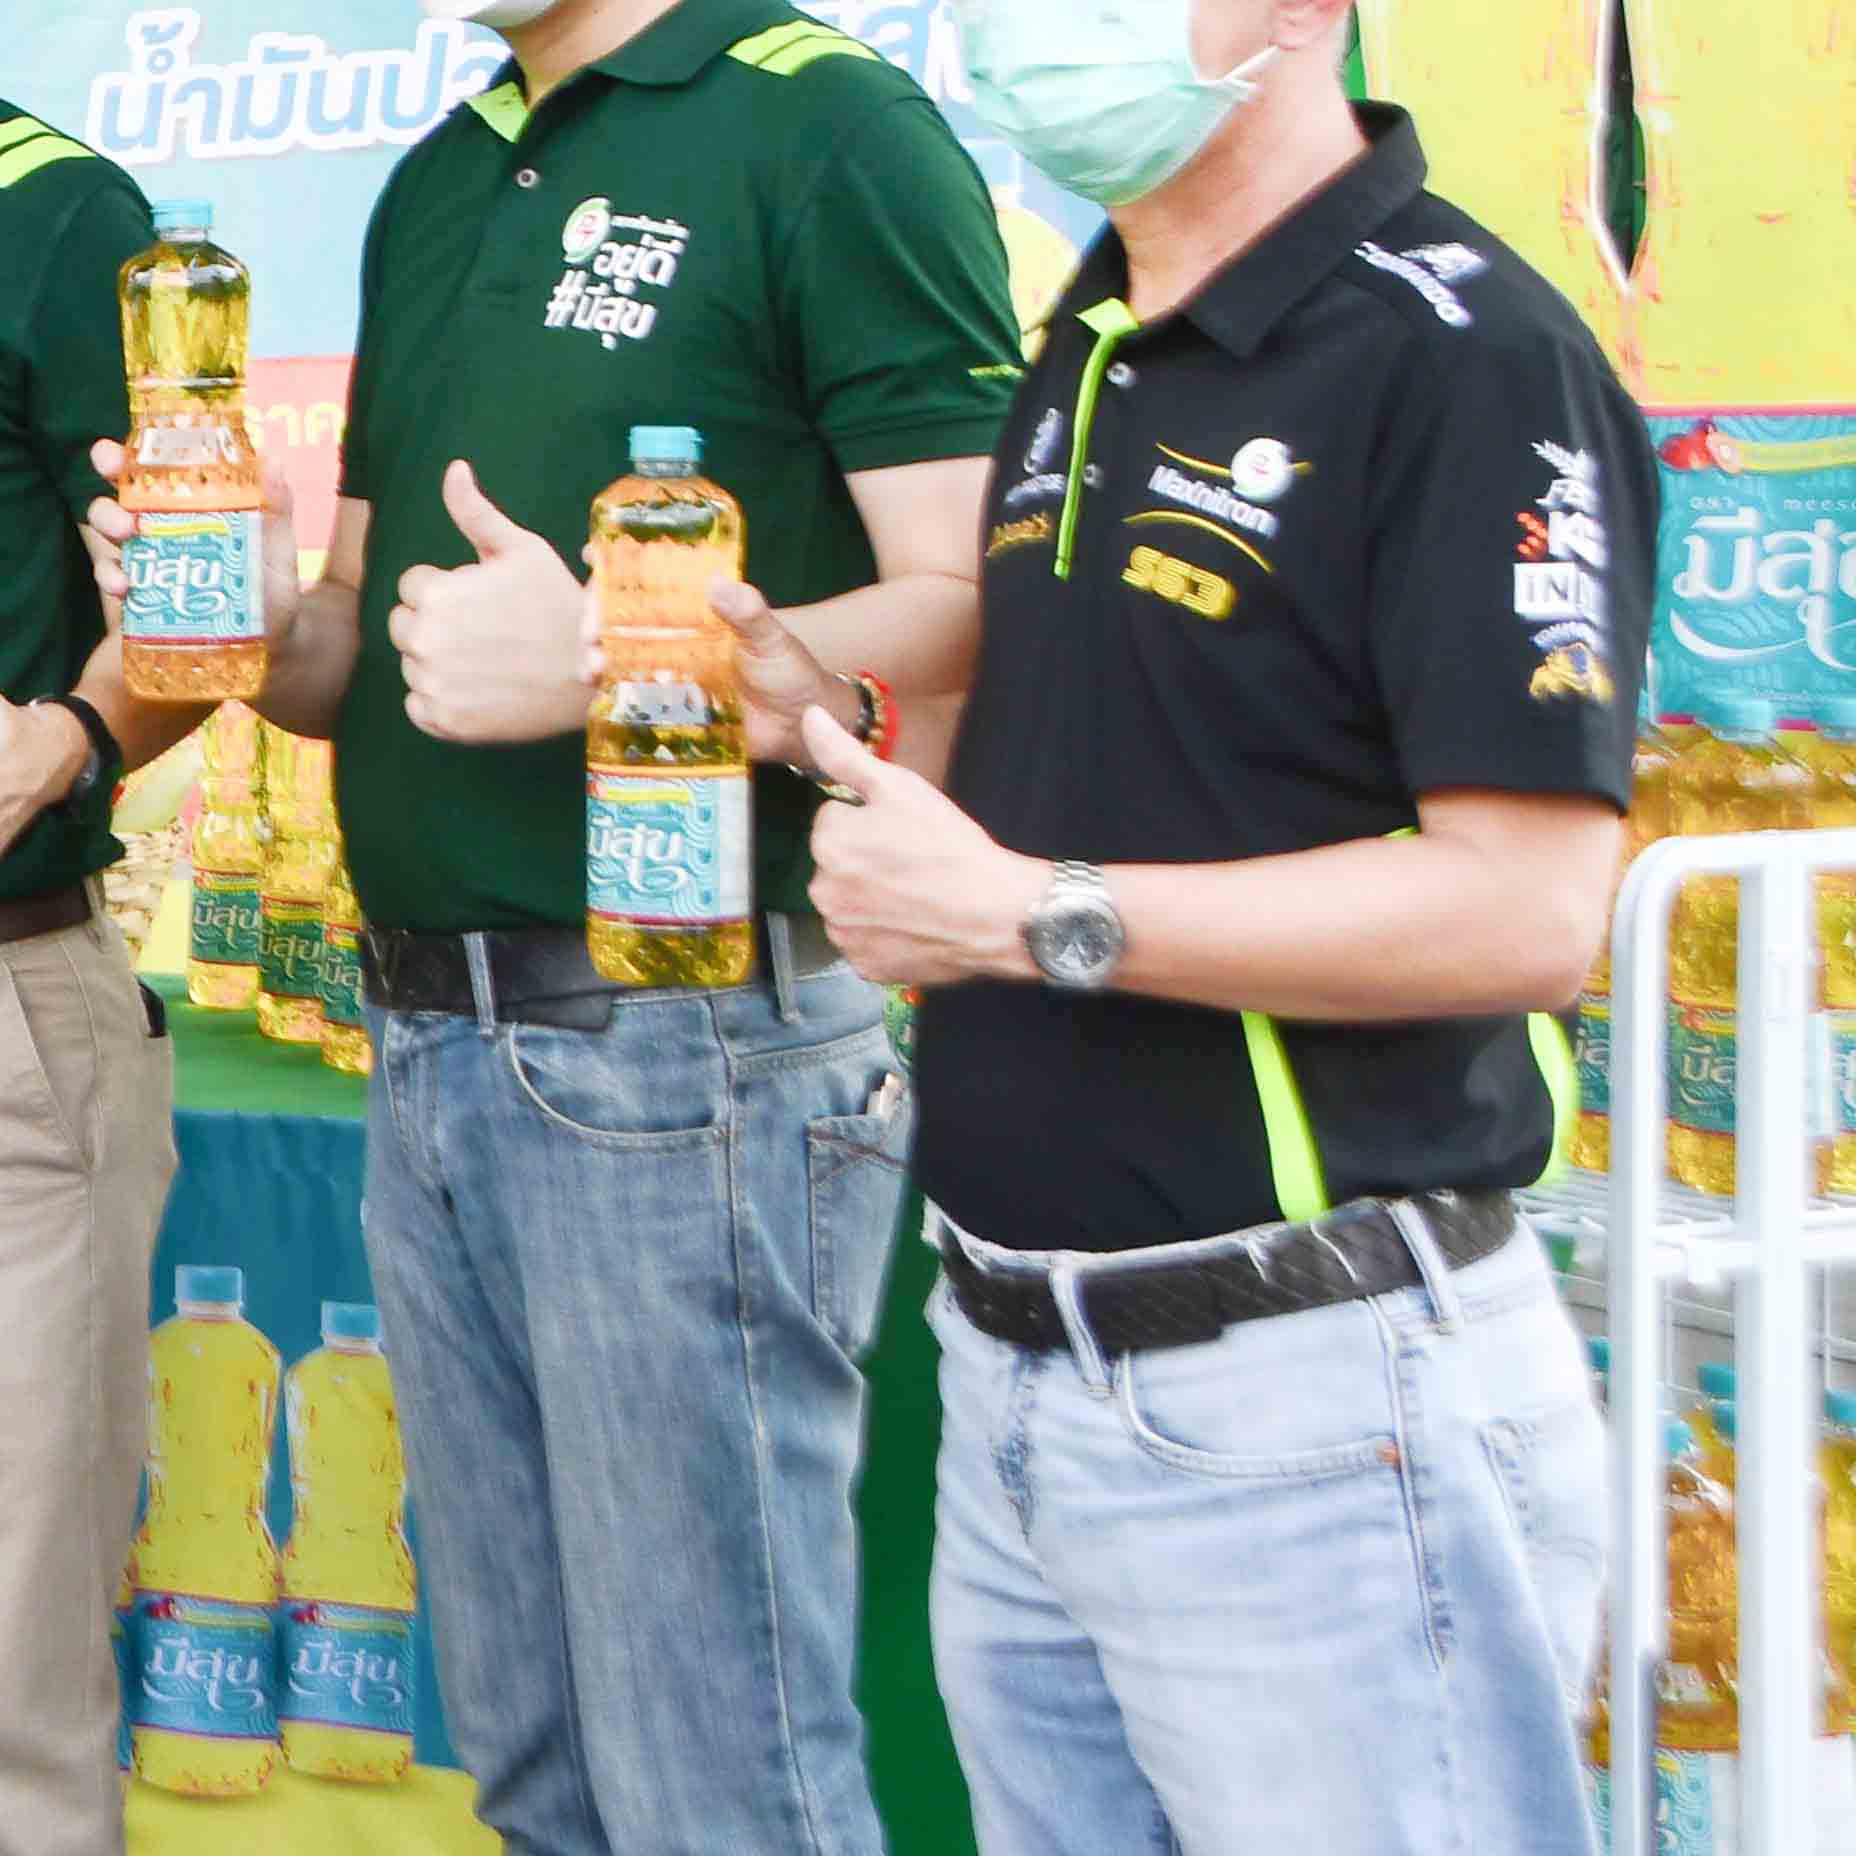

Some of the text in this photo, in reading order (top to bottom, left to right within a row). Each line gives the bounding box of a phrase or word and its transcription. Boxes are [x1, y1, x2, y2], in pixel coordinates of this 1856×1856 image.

[593, 233, 685, 295] อยู่ดี
[126, 548, 227, 615] มีสุข
[143, 1634, 264, 1713] มีสุข
[288, 1639, 404, 1707] มีสุข
